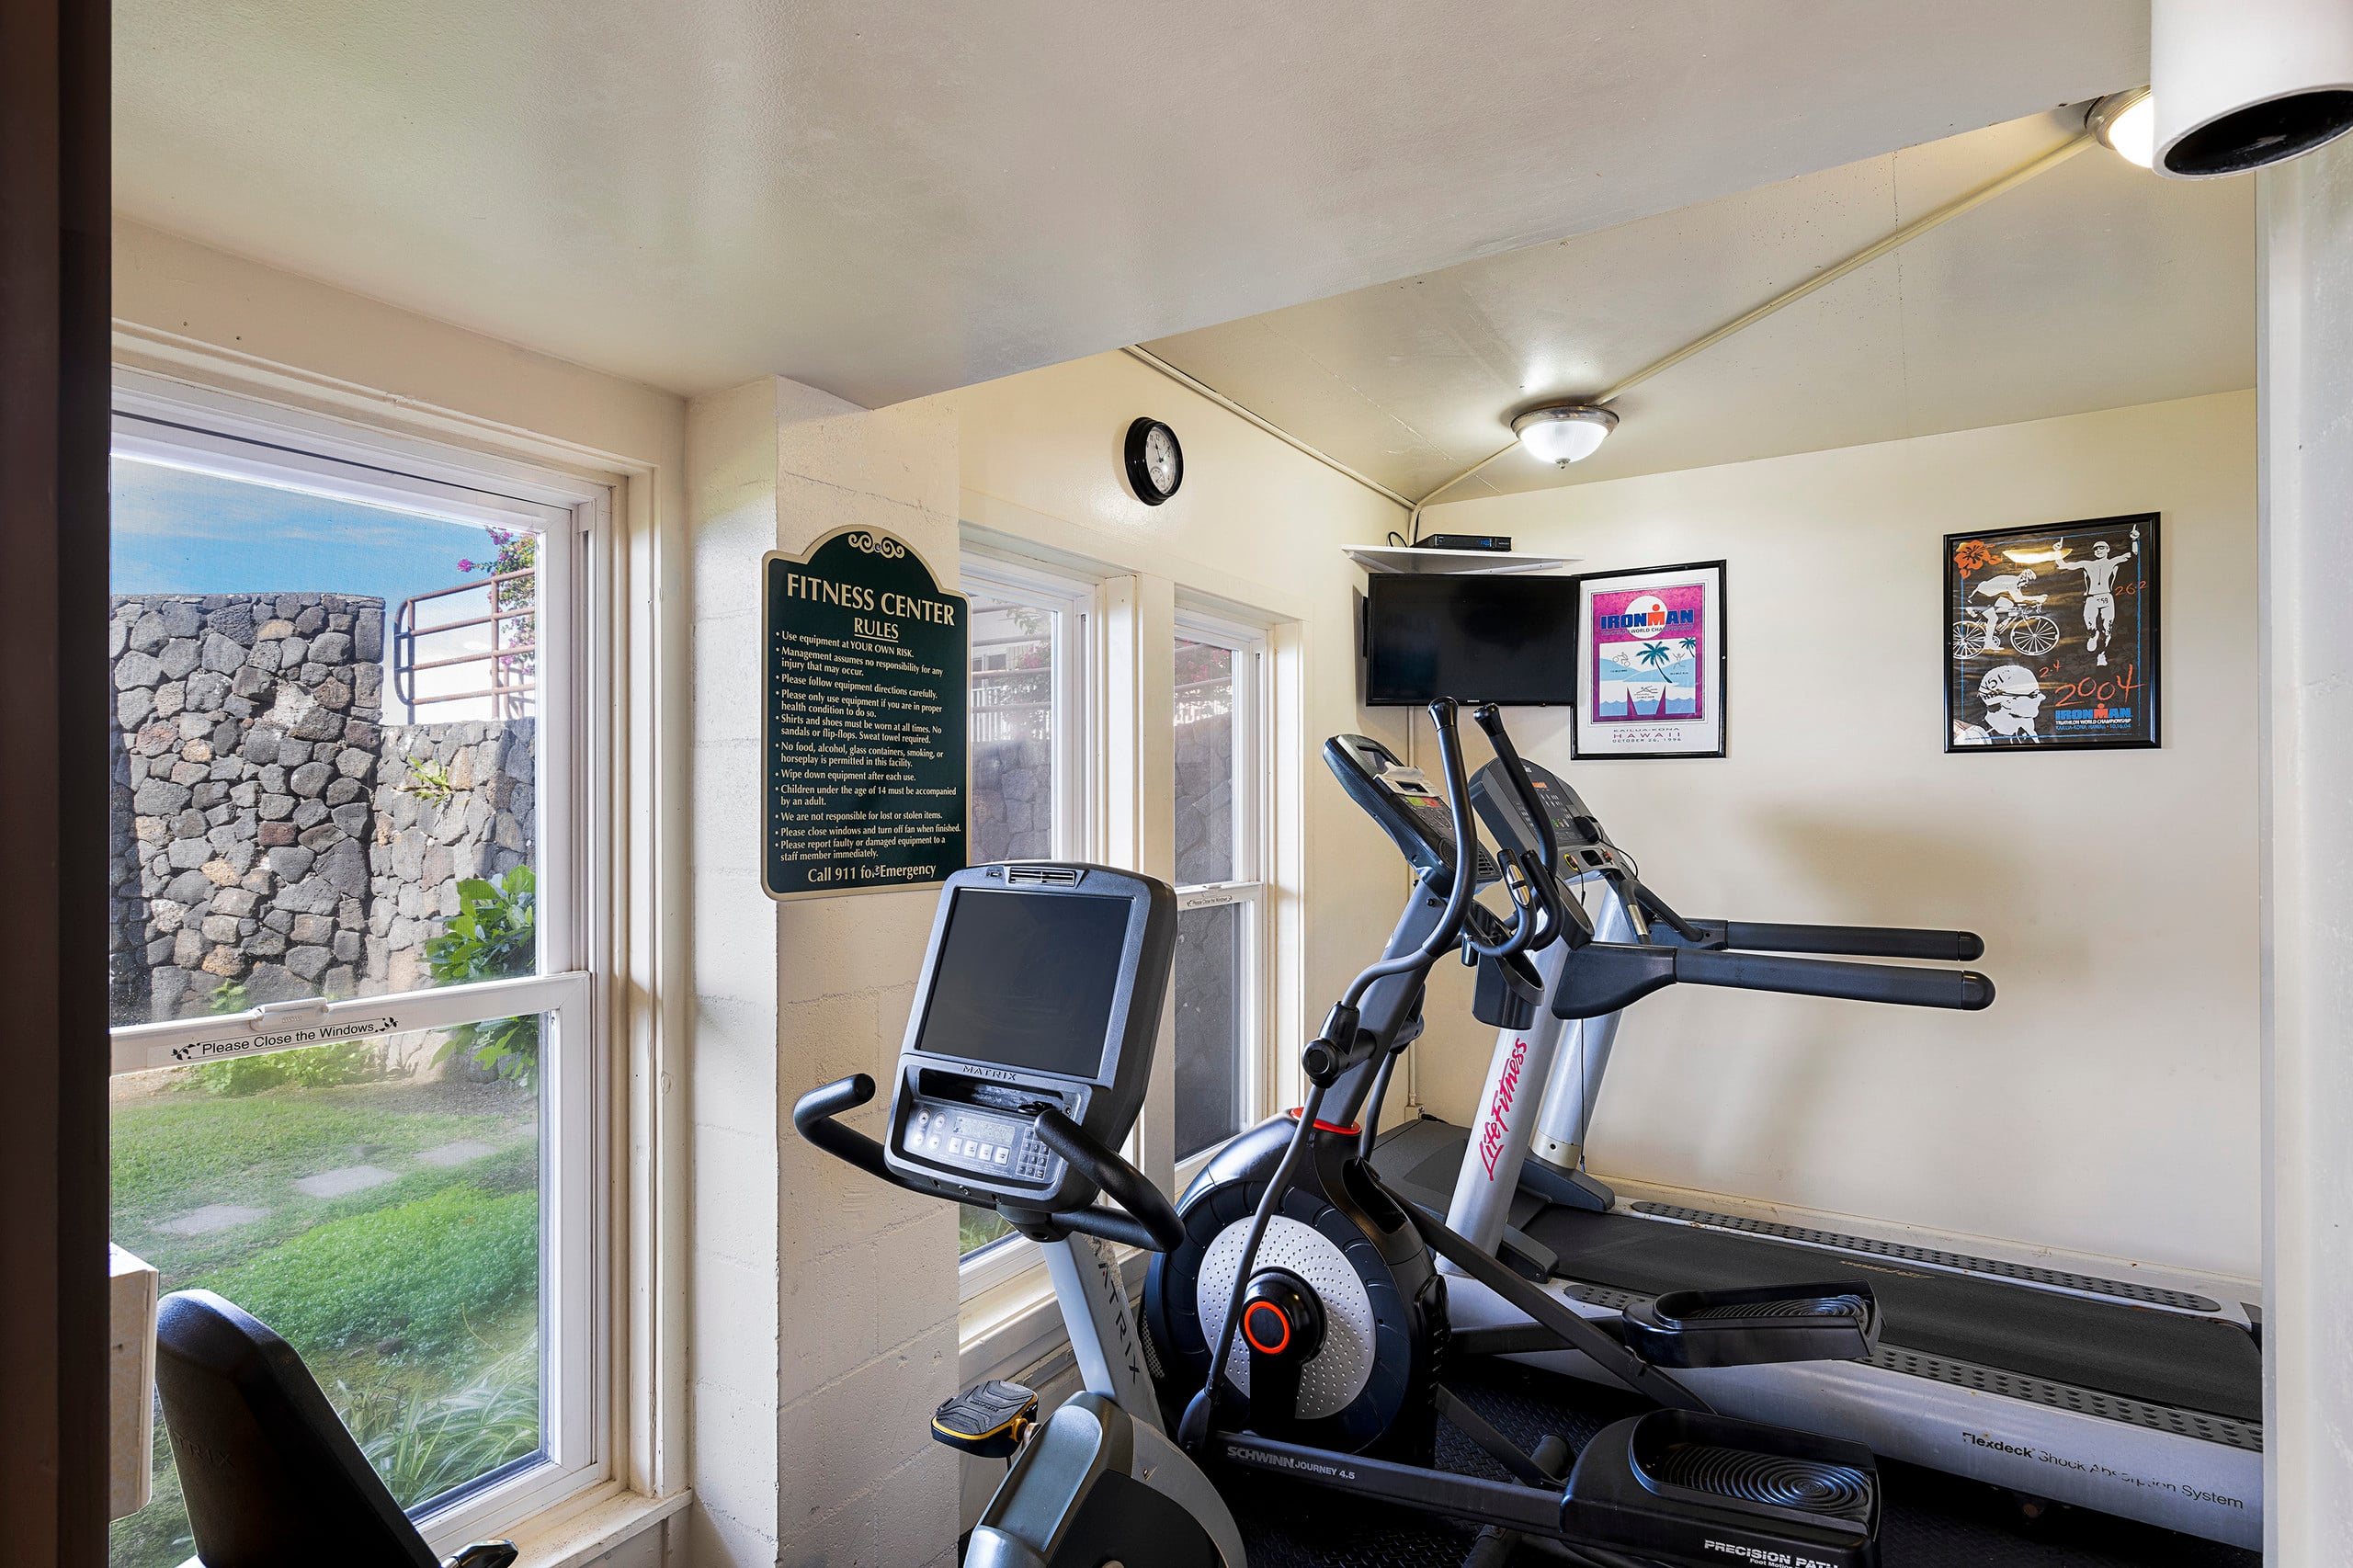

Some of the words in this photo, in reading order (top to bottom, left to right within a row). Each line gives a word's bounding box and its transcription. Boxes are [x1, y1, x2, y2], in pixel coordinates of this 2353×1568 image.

[2115, 580, 2146, 596] 26.2
[787, 573, 874, 611] FITNESS
[881, 593, 955, 626] CENTER
[1600, 605, 1694, 629] IRONMAN
[854, 618, 899, 639] RULES
[782, 631, 797, 642] Use
[800, 633, 840, 648] equipment
[841, 640, 849, 648] at
[850, 641, 873, 653] YOUR
[875, 644, 894, 655] OWN
[896, 647, 914, 658] RISK.
[781, 647, 832, 661] Management
[834, 653, 863, 665] assumes
[876, 660, 919, 675] responsibility
[921, 664, 931, 674] for
[932, 668, 943, 676] any
[781, 659, 803, 671] injury
[807, 662, 823, 672] that
[824, 665, 839, 676] may
[841, 667, 864, 676] occur.
[2040, 660, 2063, 678] 2.4
[782, 674, 806, 685] Please
[808, 676, 832, 687] follow
[835, 680, 872, 692] equipment
[874, 684, 907, 696] directions
[909, 687, 938, 699] carefully.
[2055, 664, 2146, 707] 2004
[781, 689, 806, 700] Please
[808, 692, 825, 704] only
[841, 697, 879, 708] equipment
[881, 699, 886, 707] if
[888, 700, 900, 710] you
[914, 702, 919, 710] in
[921, 705, 942, 714] proper
[781, 701, 806, 711] health
[808, 704, 844, 715] condition
[856, 708, 865, 717] do
[2055, 704, 2131, 720] IRONMAN
[781, 714, 803, 724] Shirts
[805, 716, 820, 725] and
[823, 716, 843, 726] shoes
[845, 719, 861, 728] must
[863, 720, 872, 729] be
[874, 722, 892, 730] worn
[902, 722, 910, 732] all
[912, 723, 930, 733] times.
[932, 726, 941, 734] No
[781, 727, 810, 736] sandals
[823, 729, 858, 740] flip-flops.
[859, 732, 880, 741] Sweat
[881, 733, 900, 742] towel
[902, 734, 931, 744] required.
[781, 743, 794, 751] No
[796, 743, 816, 753] food,
[818, 744, 847, 755] alcohol,
[849, 746, 867, 756] glass
[869, 747, 905, 756] containers,
[906, 748, 935, 760] smoking,
[781, 754, 819, 766] horseplay
[828, 756, 864, 767] permitted
[874, 757, 887, 766] this
[889, 757, 913, 769] facility.
[781, 769, 802, 780] Wipe
[804, 769, 825, 778] down
[827, 771, 866, 782] equipment
[868, 771, 884, 780] after
[886, 772, 902, 780] each
[781, 785, 814, 794] Children
[817, 785, 838, 794] under
[841, 786, 852, 794] the
[854, 788, 867, 797] age
[869, 786, 876, 795] of
[878, 787, 886, 795] 14
[905, 787, 914, 795] be
[915, 787, 956, 796] accompanied
[781, 797, 790, 807] by
[804, 797, 826, 805] adult.
[781, 812, 794, 821] We
[811, 812, 824, 821] not
[825, 811, 866, 823] responsible
[869, 811, 878, 820] for
[880, 811, 892, 820] lost
[903, 811, 923, 819] stolen
[924, 811, 942, 819] items.
[781, 827, 805, 836] Please
[807, 826, 827, 835] close
[829, 825, 861, 835] windows
[862, 825, 876, 835] and
[893, 824, 904, 834] off
[904, 824, 915, 833] fan
[916, 824, 934, 833] when
[936, 824, 961, 832] finished.
[781, 840, 805, 849] Please
[807, 839, 831, 851] report
[833, 838, 854, 849] faulty
[865, 837, 896, 846] damaged
[898, 836, 932, 846] equipment
[780, 852, 798, 861] staff
[800, 851, 831, 860] member
[833, 849, 878, 858] immediately.
[808, 868, 831, 882] Call
[835, 867, 856, 880] 911
[880, 864, 937, 878] Emergency
[202, 1040, 250, 1054] Please
[254, 1034, 292, 1048] Close
[296, 1029, 315, 1041] the
[320, 1023, 374, 1038] Windows
[963, 1066, 1017, 1081] MATRIX
[1228, 1447, 1294, 1469] SCHWINN
[1295, 1461, 1336, 1476] JOURNEY
[1339, 1471, 1355, 1480] 4.5
[2182, 1485, 2244, 1509] System
[1704, 1540, 1790, 1564] PRECISION
[1750, 1558, 1767, 1566] Foot
